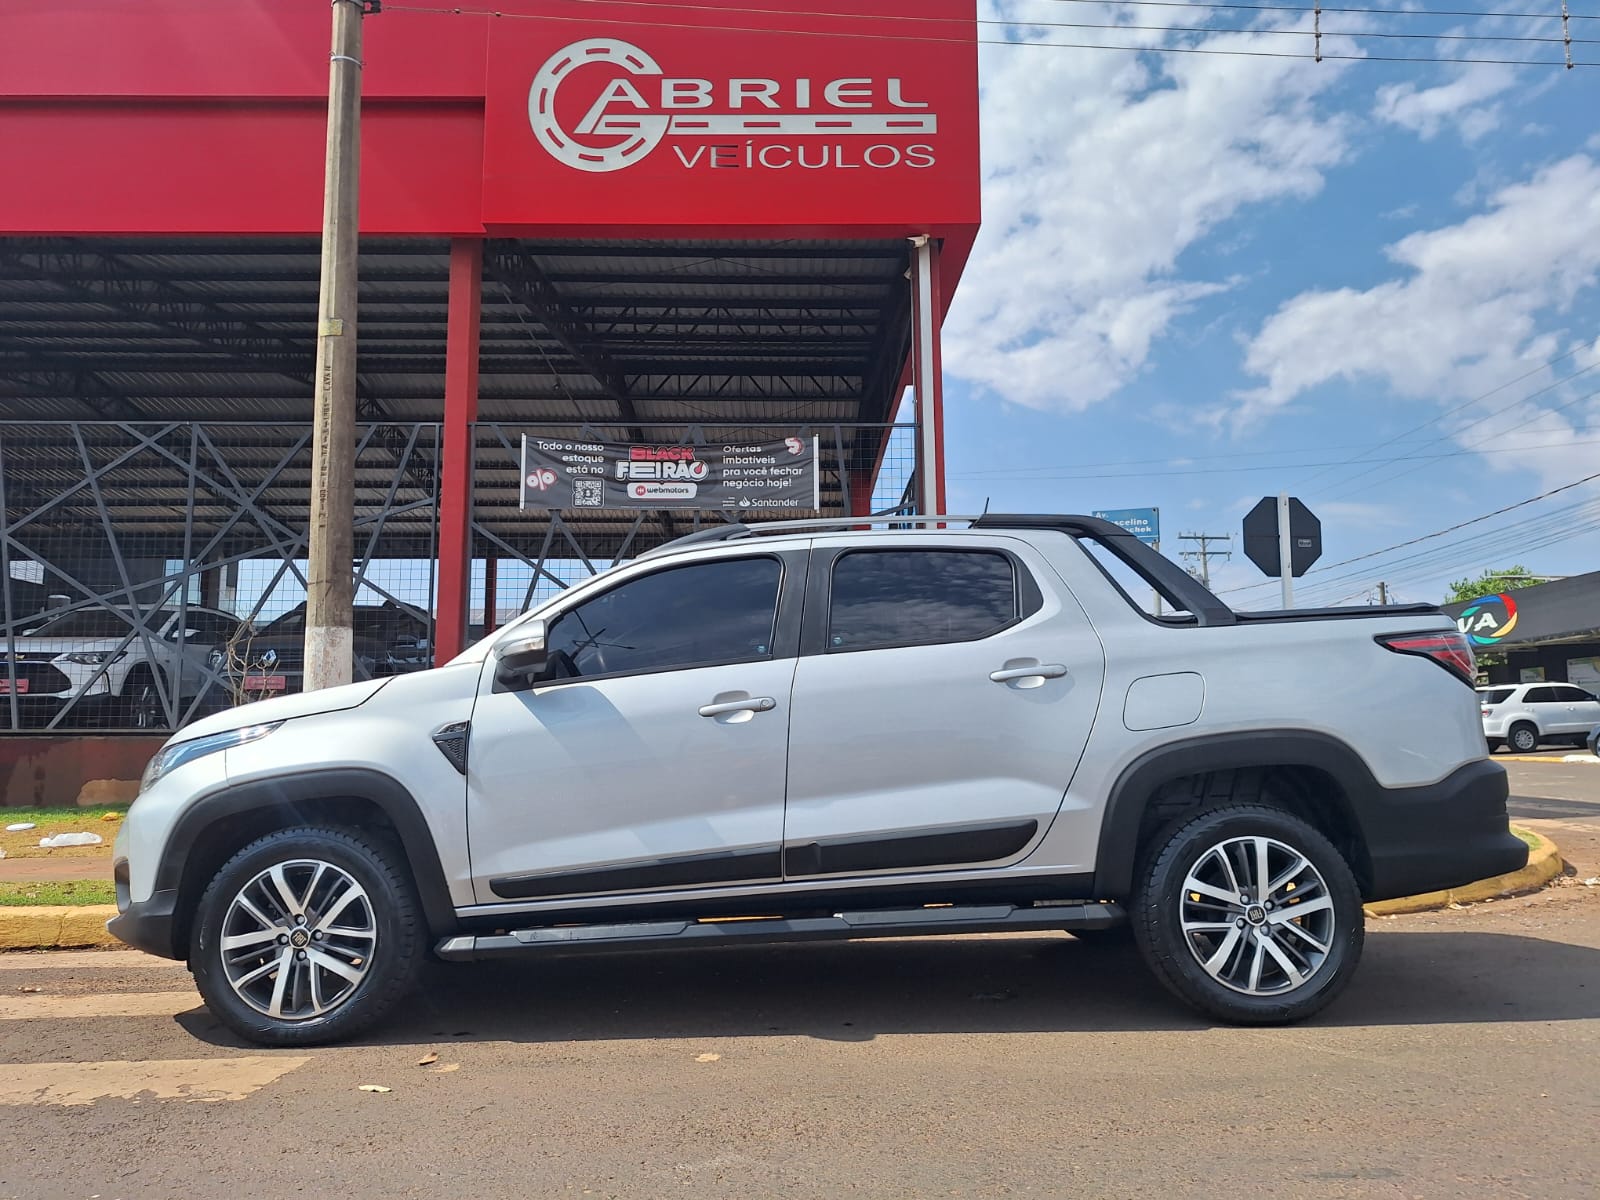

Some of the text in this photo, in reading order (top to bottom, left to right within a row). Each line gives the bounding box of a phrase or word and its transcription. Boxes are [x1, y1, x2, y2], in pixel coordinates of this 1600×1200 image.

[528, 38, 932, 173] GABRIEL
[672, 140, 937, 169] VEÍCULOS
[537, 441, 605, 452] Todo o nosso
[723, 445, 762, 453] Ofertas
[630, 446, 695, 461] BLACK
[562, 455, 605, 464] estoque
[565, 465, 604, 475] está no
[616, 460, 708, 479] FEIRÃO
[722, 466, 803, 477] pra você fechar
[722, 478, 792, 489] negócio hoje!
[751, 498, 799, 507] Santander
[1095, 511, 1110, 519] Av.
[1111, 518, 1148, 526] scelino
